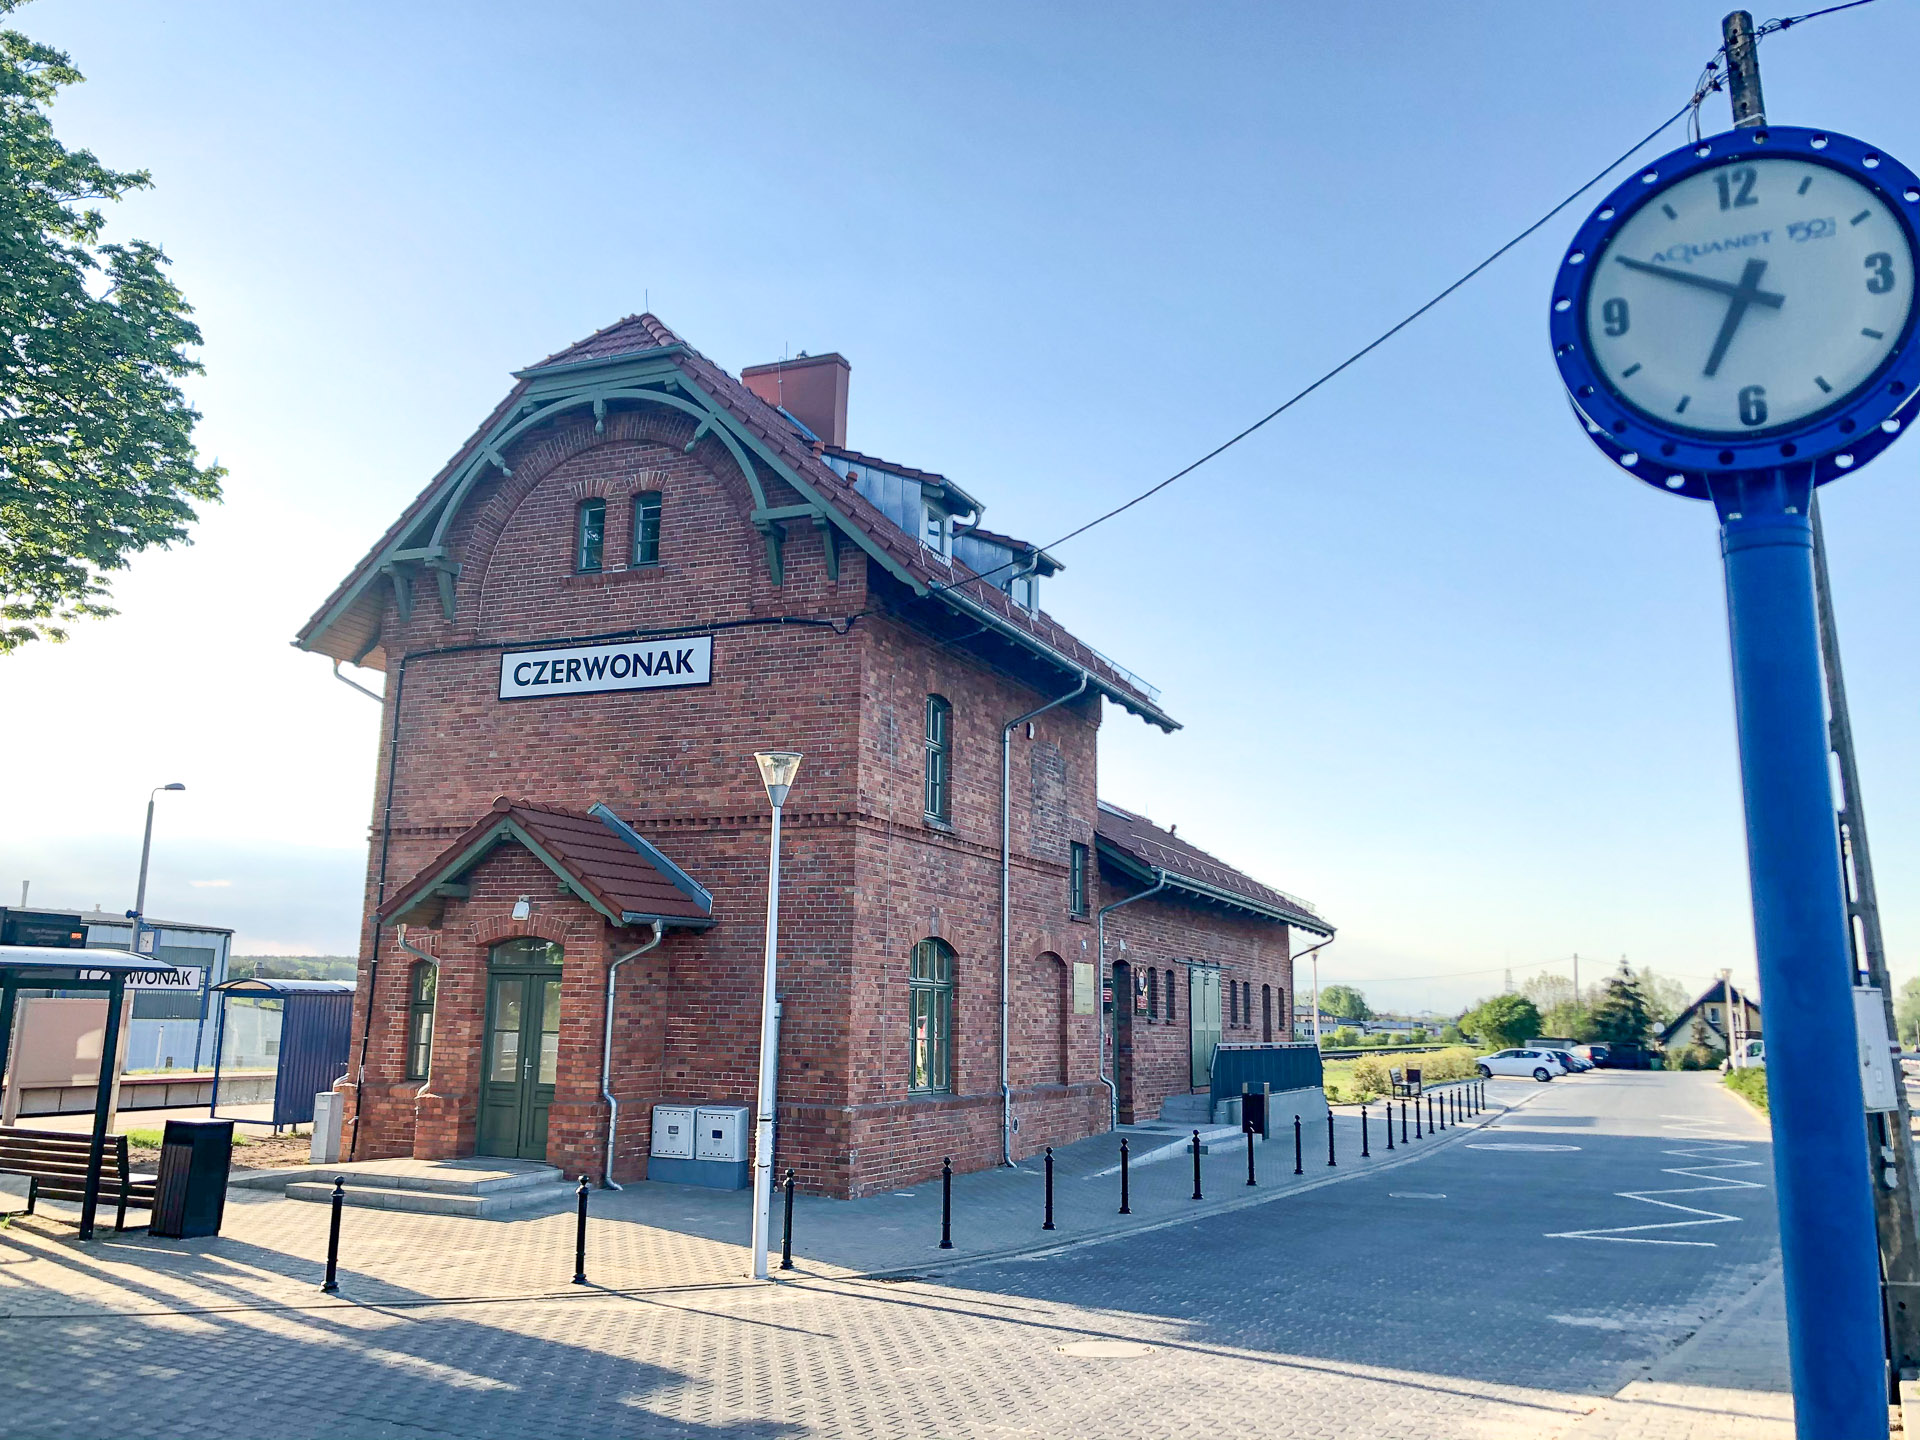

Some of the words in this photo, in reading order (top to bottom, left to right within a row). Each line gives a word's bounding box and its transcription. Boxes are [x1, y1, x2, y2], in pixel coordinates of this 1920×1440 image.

[1713, 168, 1758, 211] 12
[1864, 253, 1895, 294] 3
[1603, 298, 1630, 336] 9
[1738, 385, 1768, 426] 6
[513, 648, 695, 686] CZERWONAK
